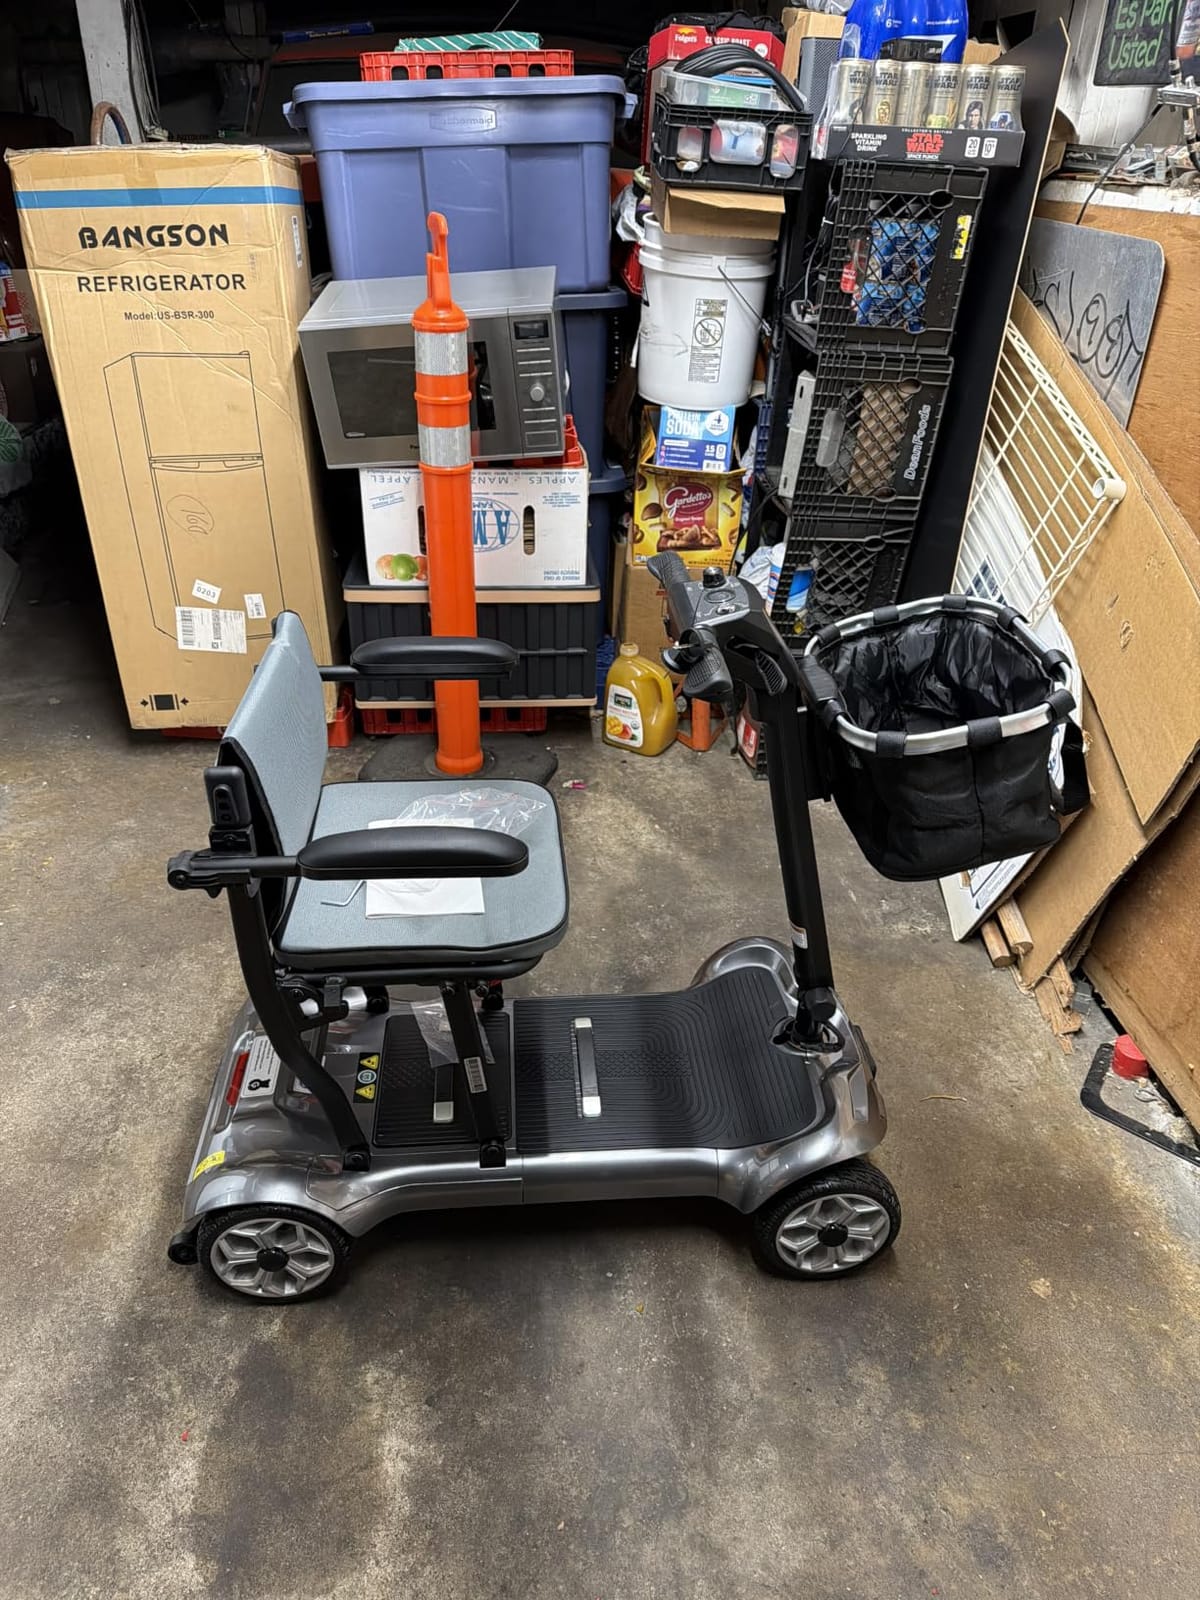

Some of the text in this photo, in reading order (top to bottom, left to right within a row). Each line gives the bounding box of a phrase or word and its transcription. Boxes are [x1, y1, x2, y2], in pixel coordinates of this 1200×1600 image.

[674, 33, 697, 43] Folgers
[1108, 28, 1164, 70] Usted
[851, 132, 888, 142] SPARKLING
[907, 133, 943, 144] STAR
[855, 139, 883, 147] VITAMIN
[857, 144, 878, 153] DRINK
[906, 142, 945, 154] WARS
[78, 223, 230, 249] BANGSON
[77, 273, 247, 293] REFRIGERATOR
[666, 419, 701, 436] SODA
[529, 475, 577, 484] APPLES
[196, 586, 217, 599] 0203
